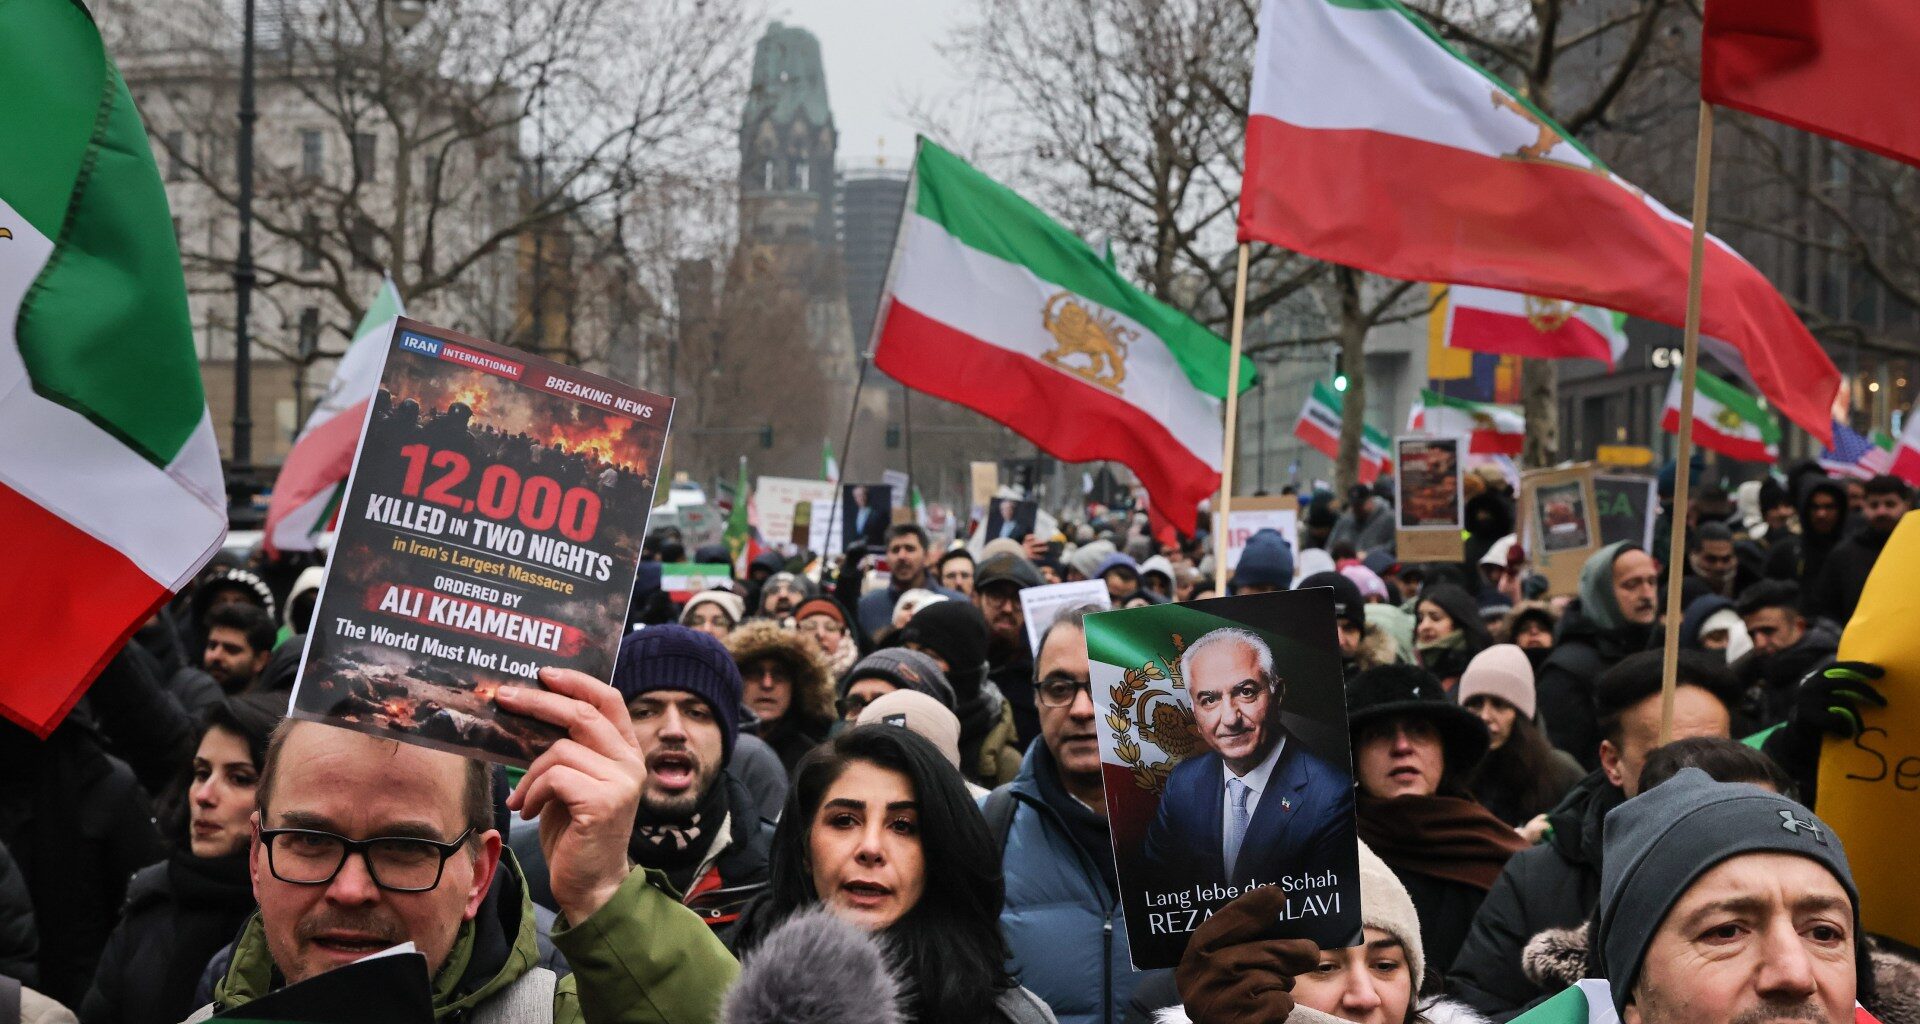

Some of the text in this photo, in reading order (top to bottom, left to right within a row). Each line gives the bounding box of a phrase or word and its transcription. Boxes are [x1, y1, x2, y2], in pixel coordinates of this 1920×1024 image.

[404, 336, 518, 376] IRAN INTERNATIONAL
[545, 375, 654, 419] BREAKING NEWS
[400, 443, 601, 543] 12,000
[365, 493, 613, 581] KILLED IN TWO NIGHTS
[392, 536, 575, 595] in Iran's Largest Massacre
[434, 575, 523, 609] ORDERED BY
[379, 585, 563, 651] ALI KHAMENEI
[335, 617, 540, 680] The World Must Not Look
[1145, 890, 1192, 909] Lang
[1196, 882, 1239, 901] lebe
[1281, 869, 1338, 892] Schah
[1279, 892, 1341, 921] LAVI
